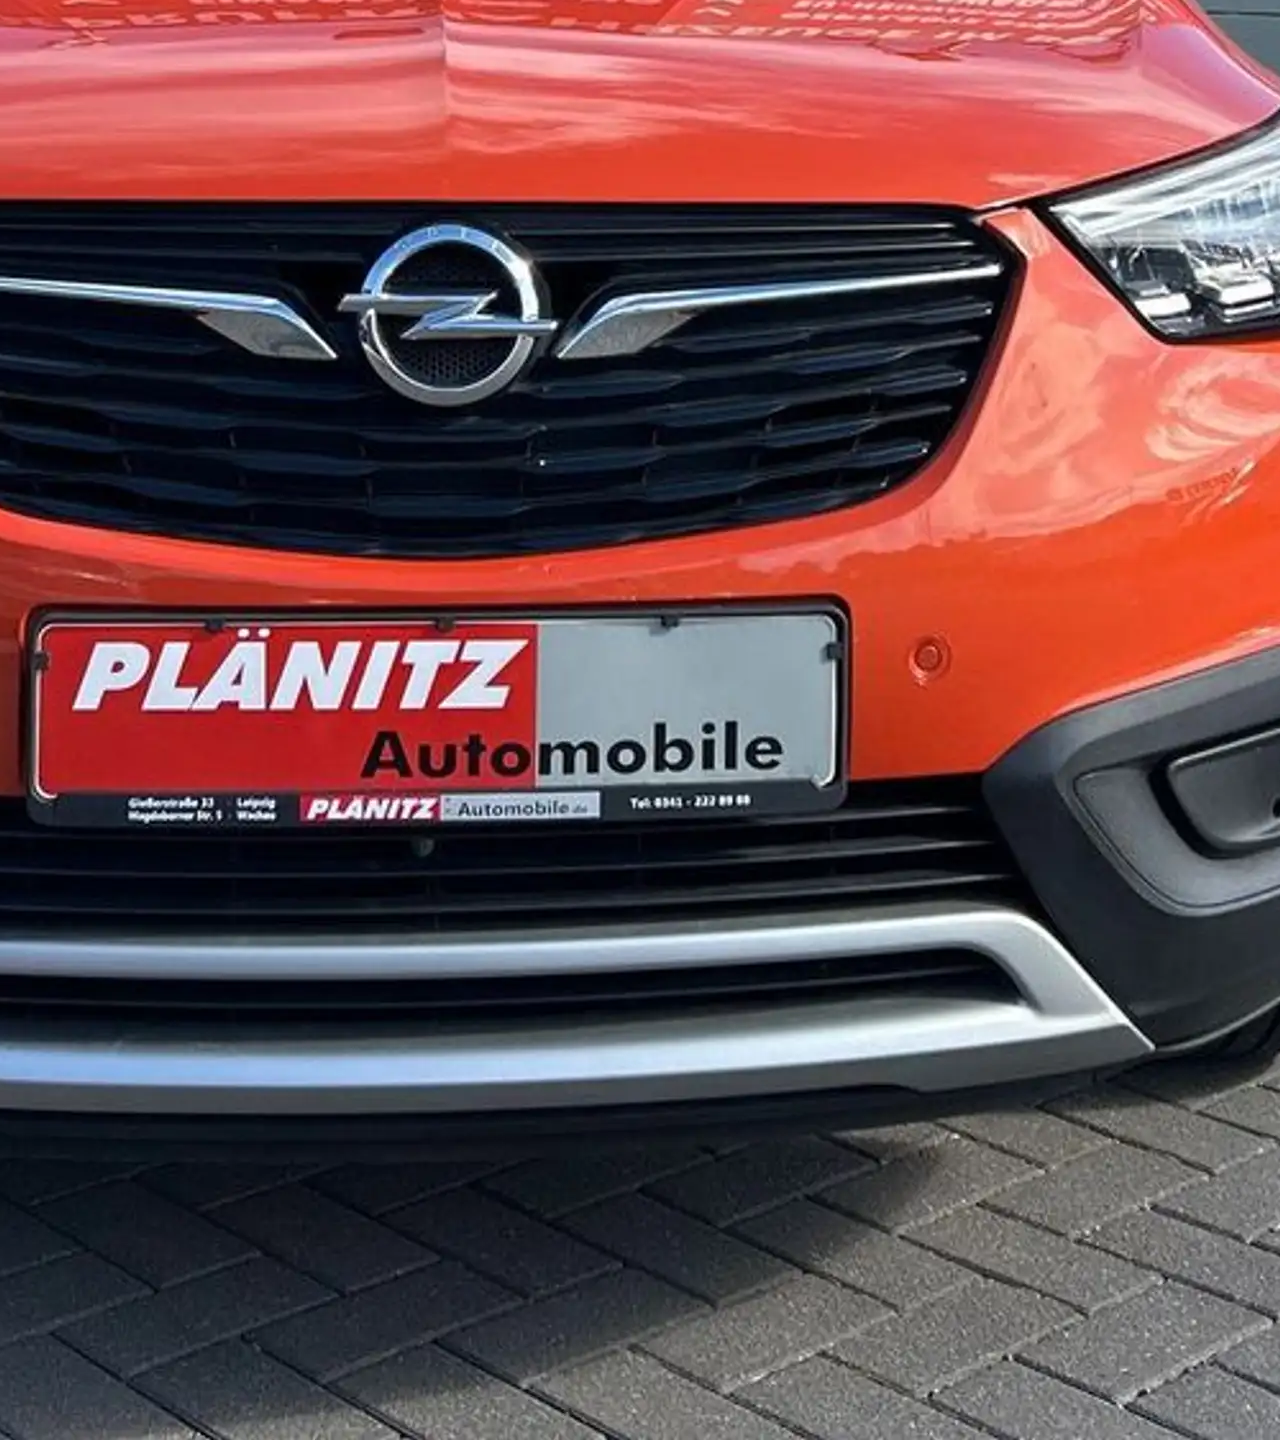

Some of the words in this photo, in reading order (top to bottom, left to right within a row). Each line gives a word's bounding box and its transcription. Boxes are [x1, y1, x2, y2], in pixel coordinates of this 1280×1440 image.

[72, 628, 529, 712] PLÄNITZ
[359, 721, 783, 780] Automobile
[307, 795, 437, 820] PLÄNITZ
